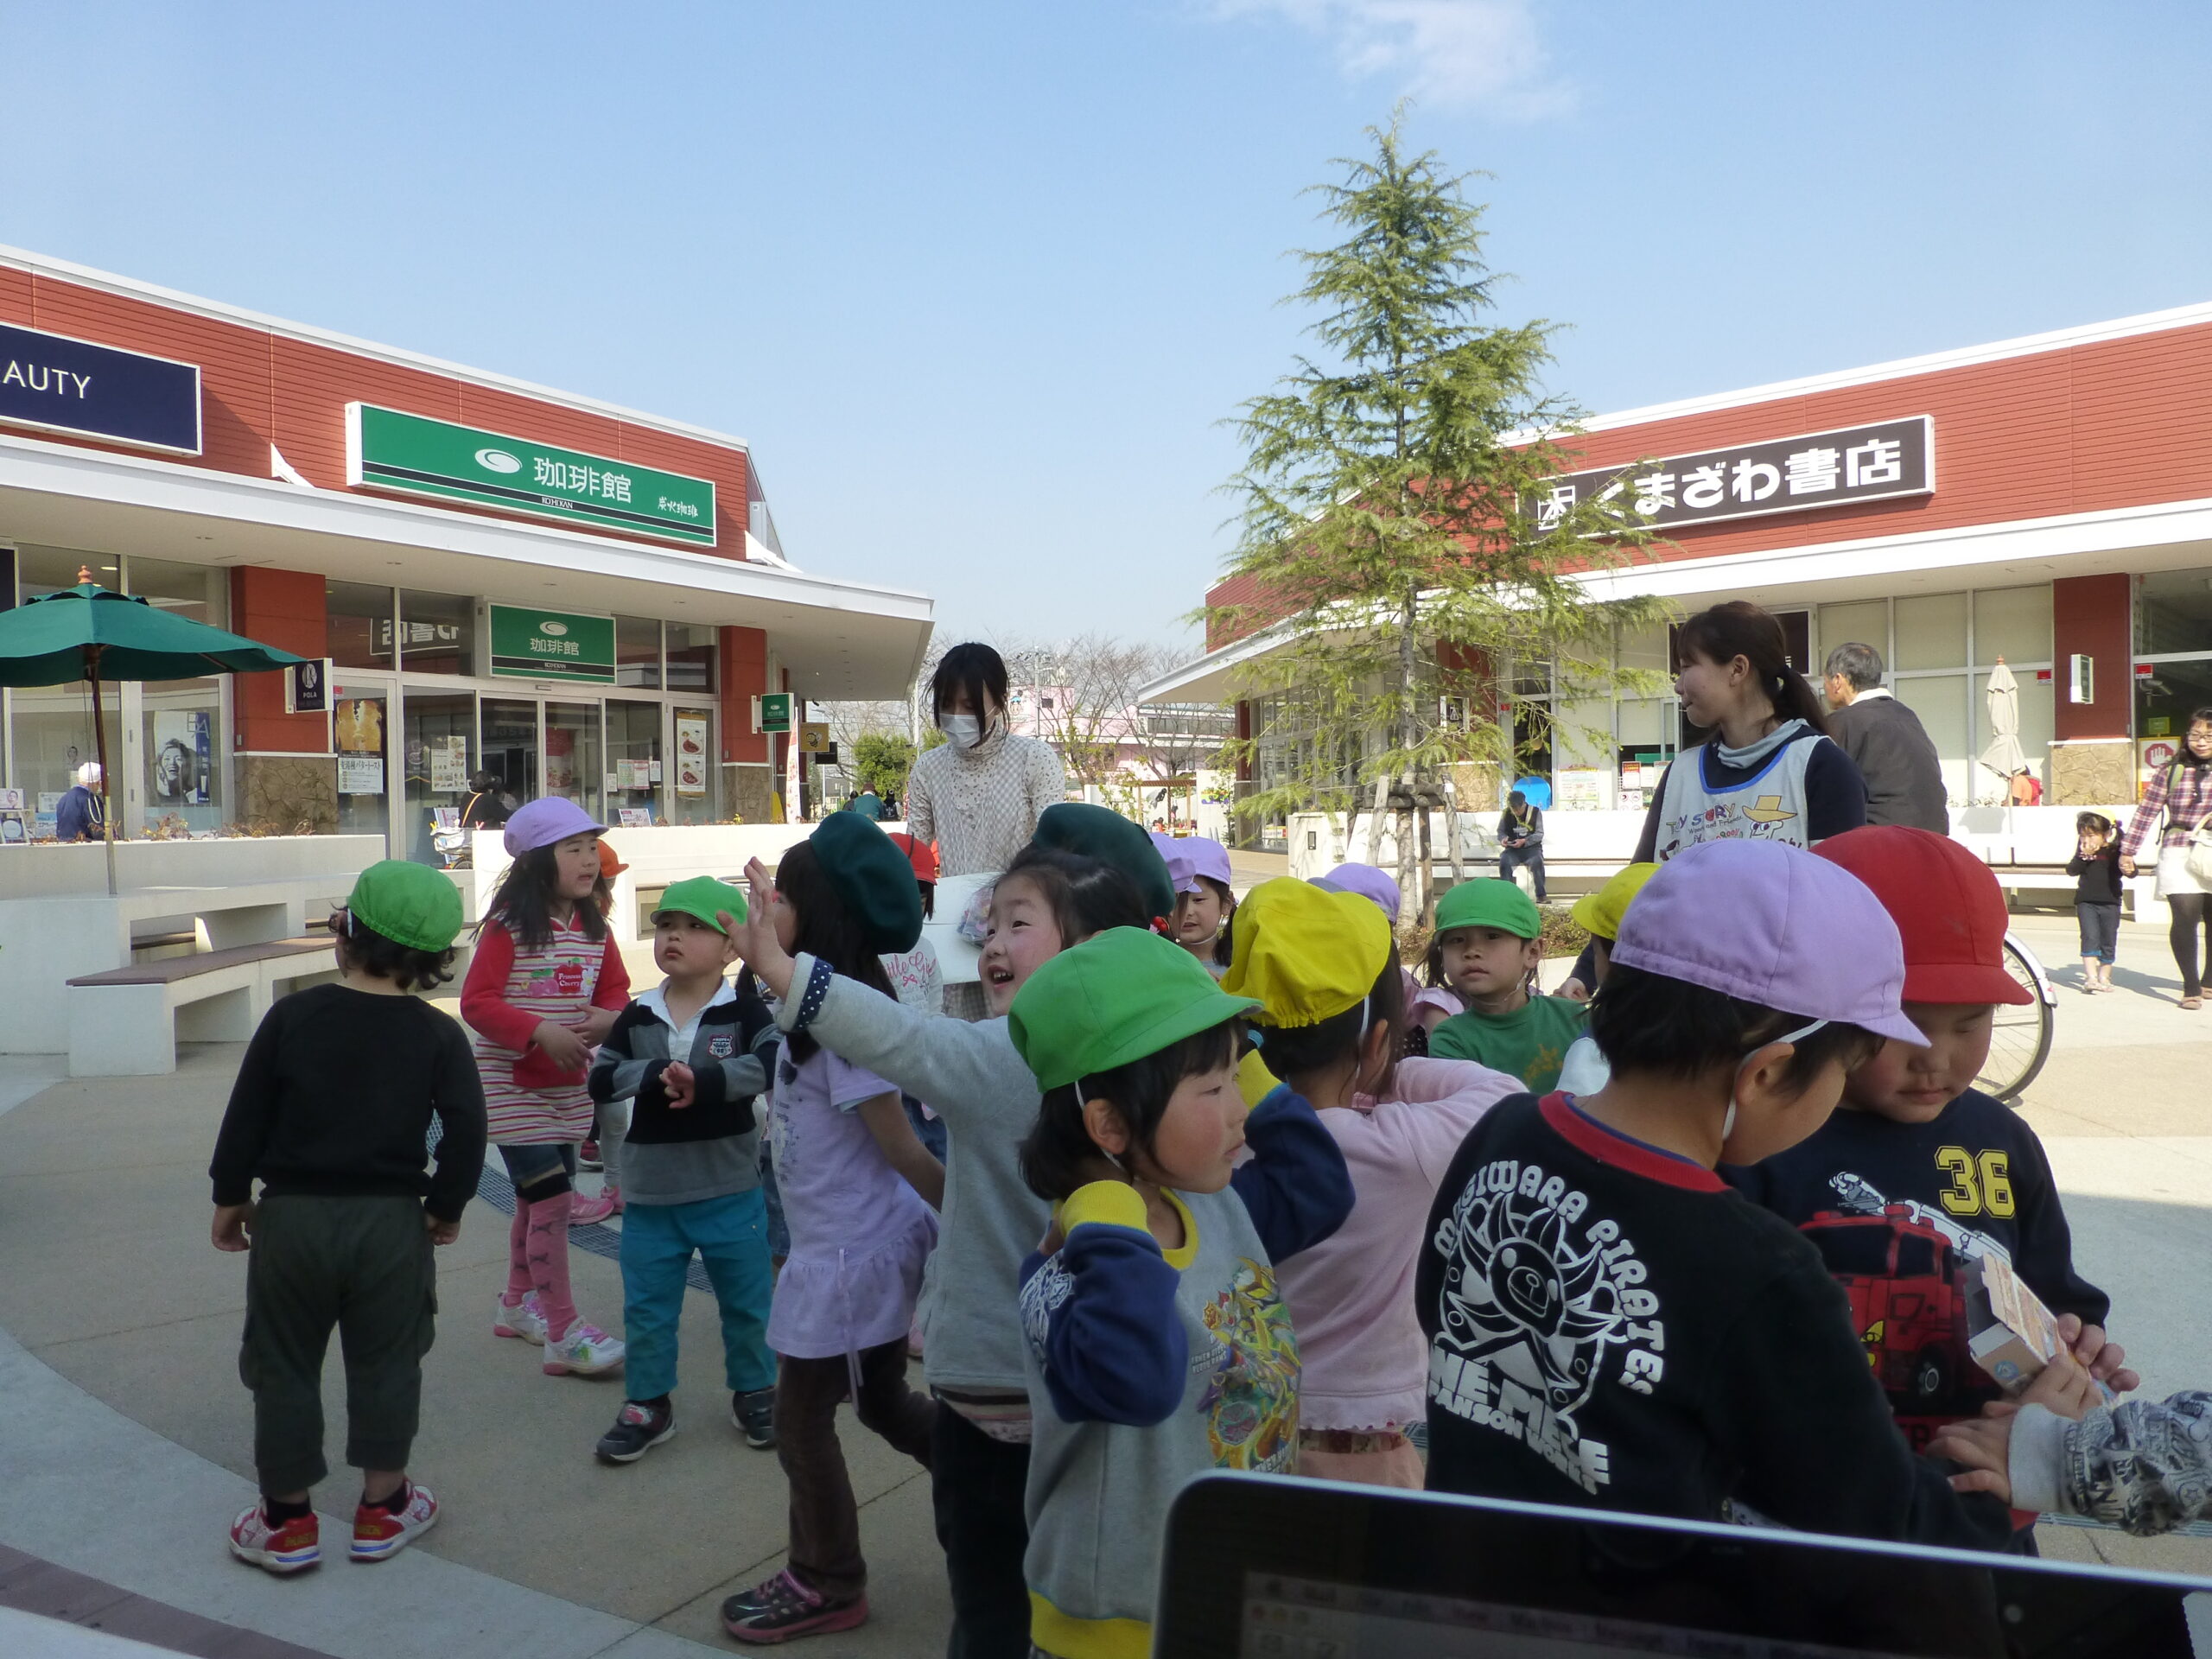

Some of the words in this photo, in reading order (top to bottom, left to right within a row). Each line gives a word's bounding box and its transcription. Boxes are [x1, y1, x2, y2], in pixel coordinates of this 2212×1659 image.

[3, 359, 91, 398] AUTY
[533, 456, 632, 504] 珈琲館
[1599, 438, 1901, 518] くまざわ書店
[658, 495, 699, 518] 炭火珈琲
[530, 638, 580, 656] 珈琲館
[1935, 1146, 2015, 1219] 36
[1586, 1219, 1664, 1395] PIRATES
